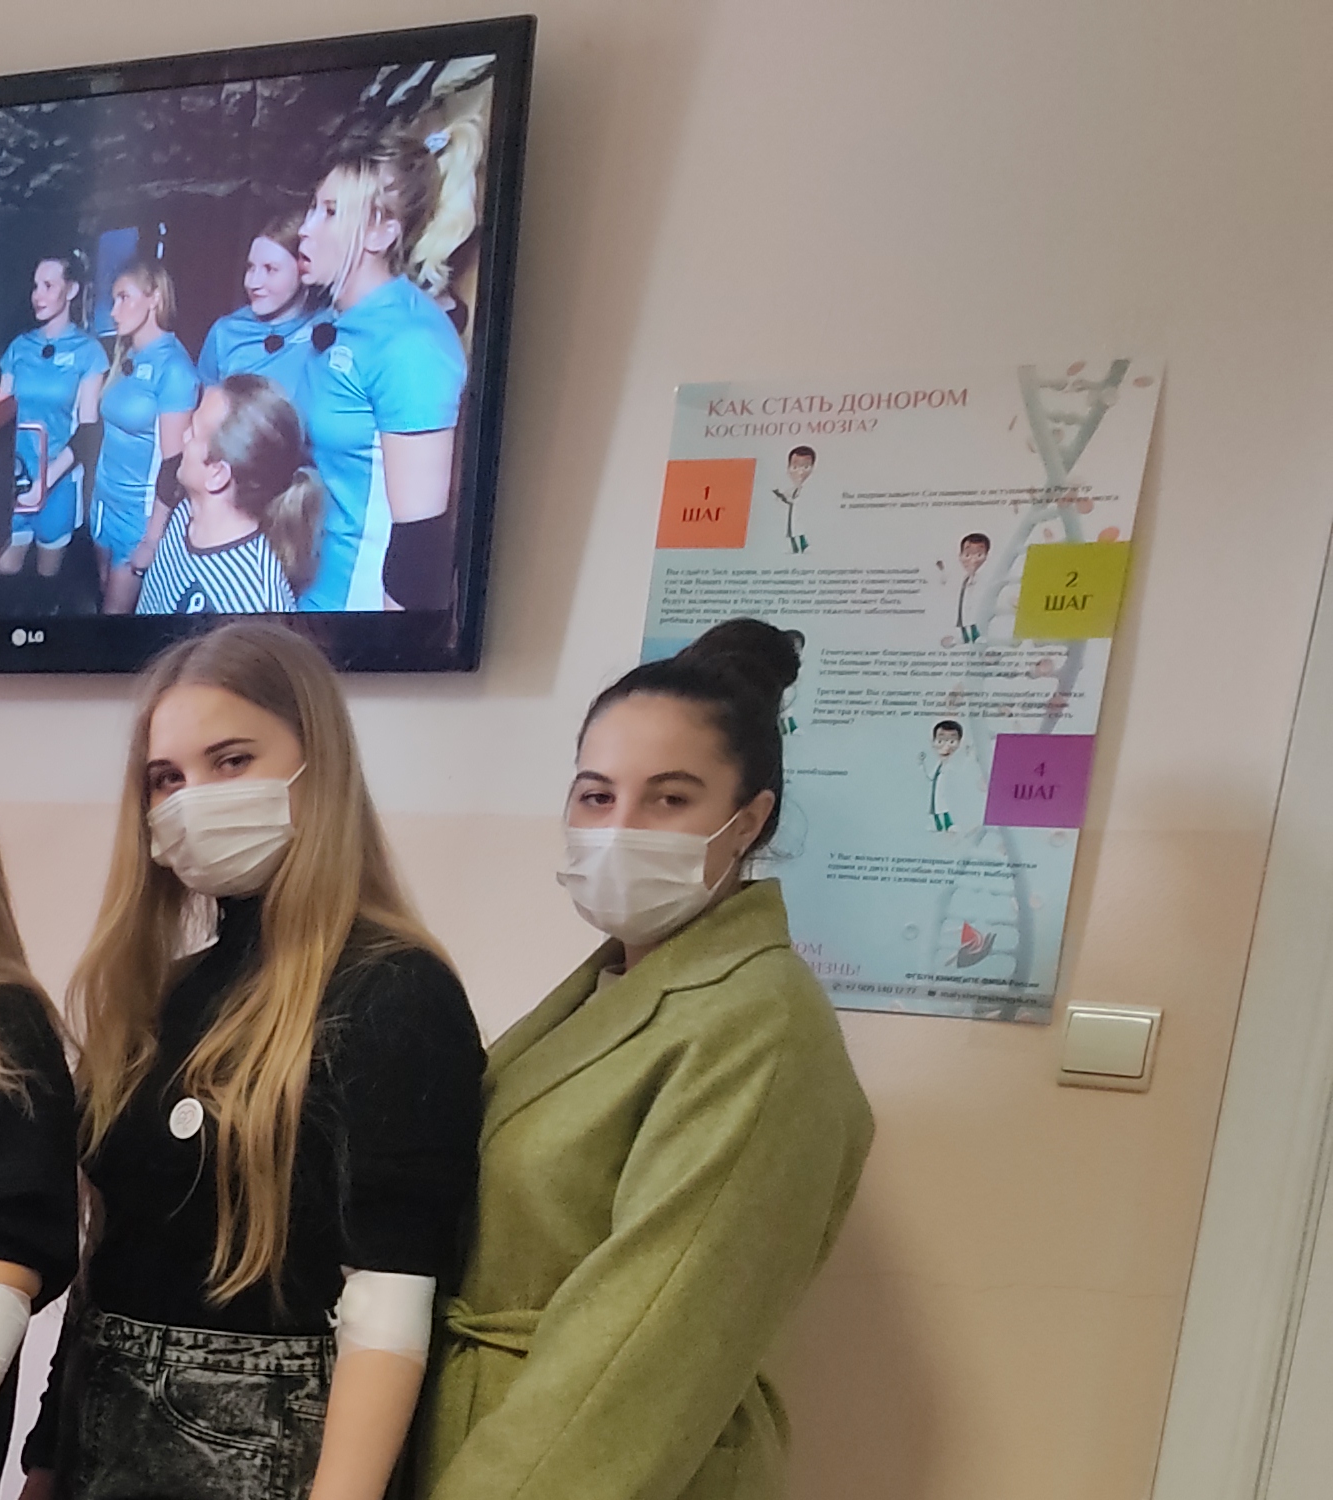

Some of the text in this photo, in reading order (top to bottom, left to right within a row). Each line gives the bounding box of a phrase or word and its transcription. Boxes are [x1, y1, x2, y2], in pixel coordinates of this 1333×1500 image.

[707, 388, 969, 417] КАК СТАТЬ ДОНОРОМ
[704, 418, 879, 438] КОСТНОГО МОЗГА?
[703, 486, 711, 500] 1
[681, 506, 726, 523] ШАГ
[1065, 571, 1079, 588] 2
[1043, 594, 1094, 611] ШАГ
[1033, 762, 1047, 777] 4
[1013, 783, 1061, 800] ШАГ
[791, 941, 823, 956] ОМ
